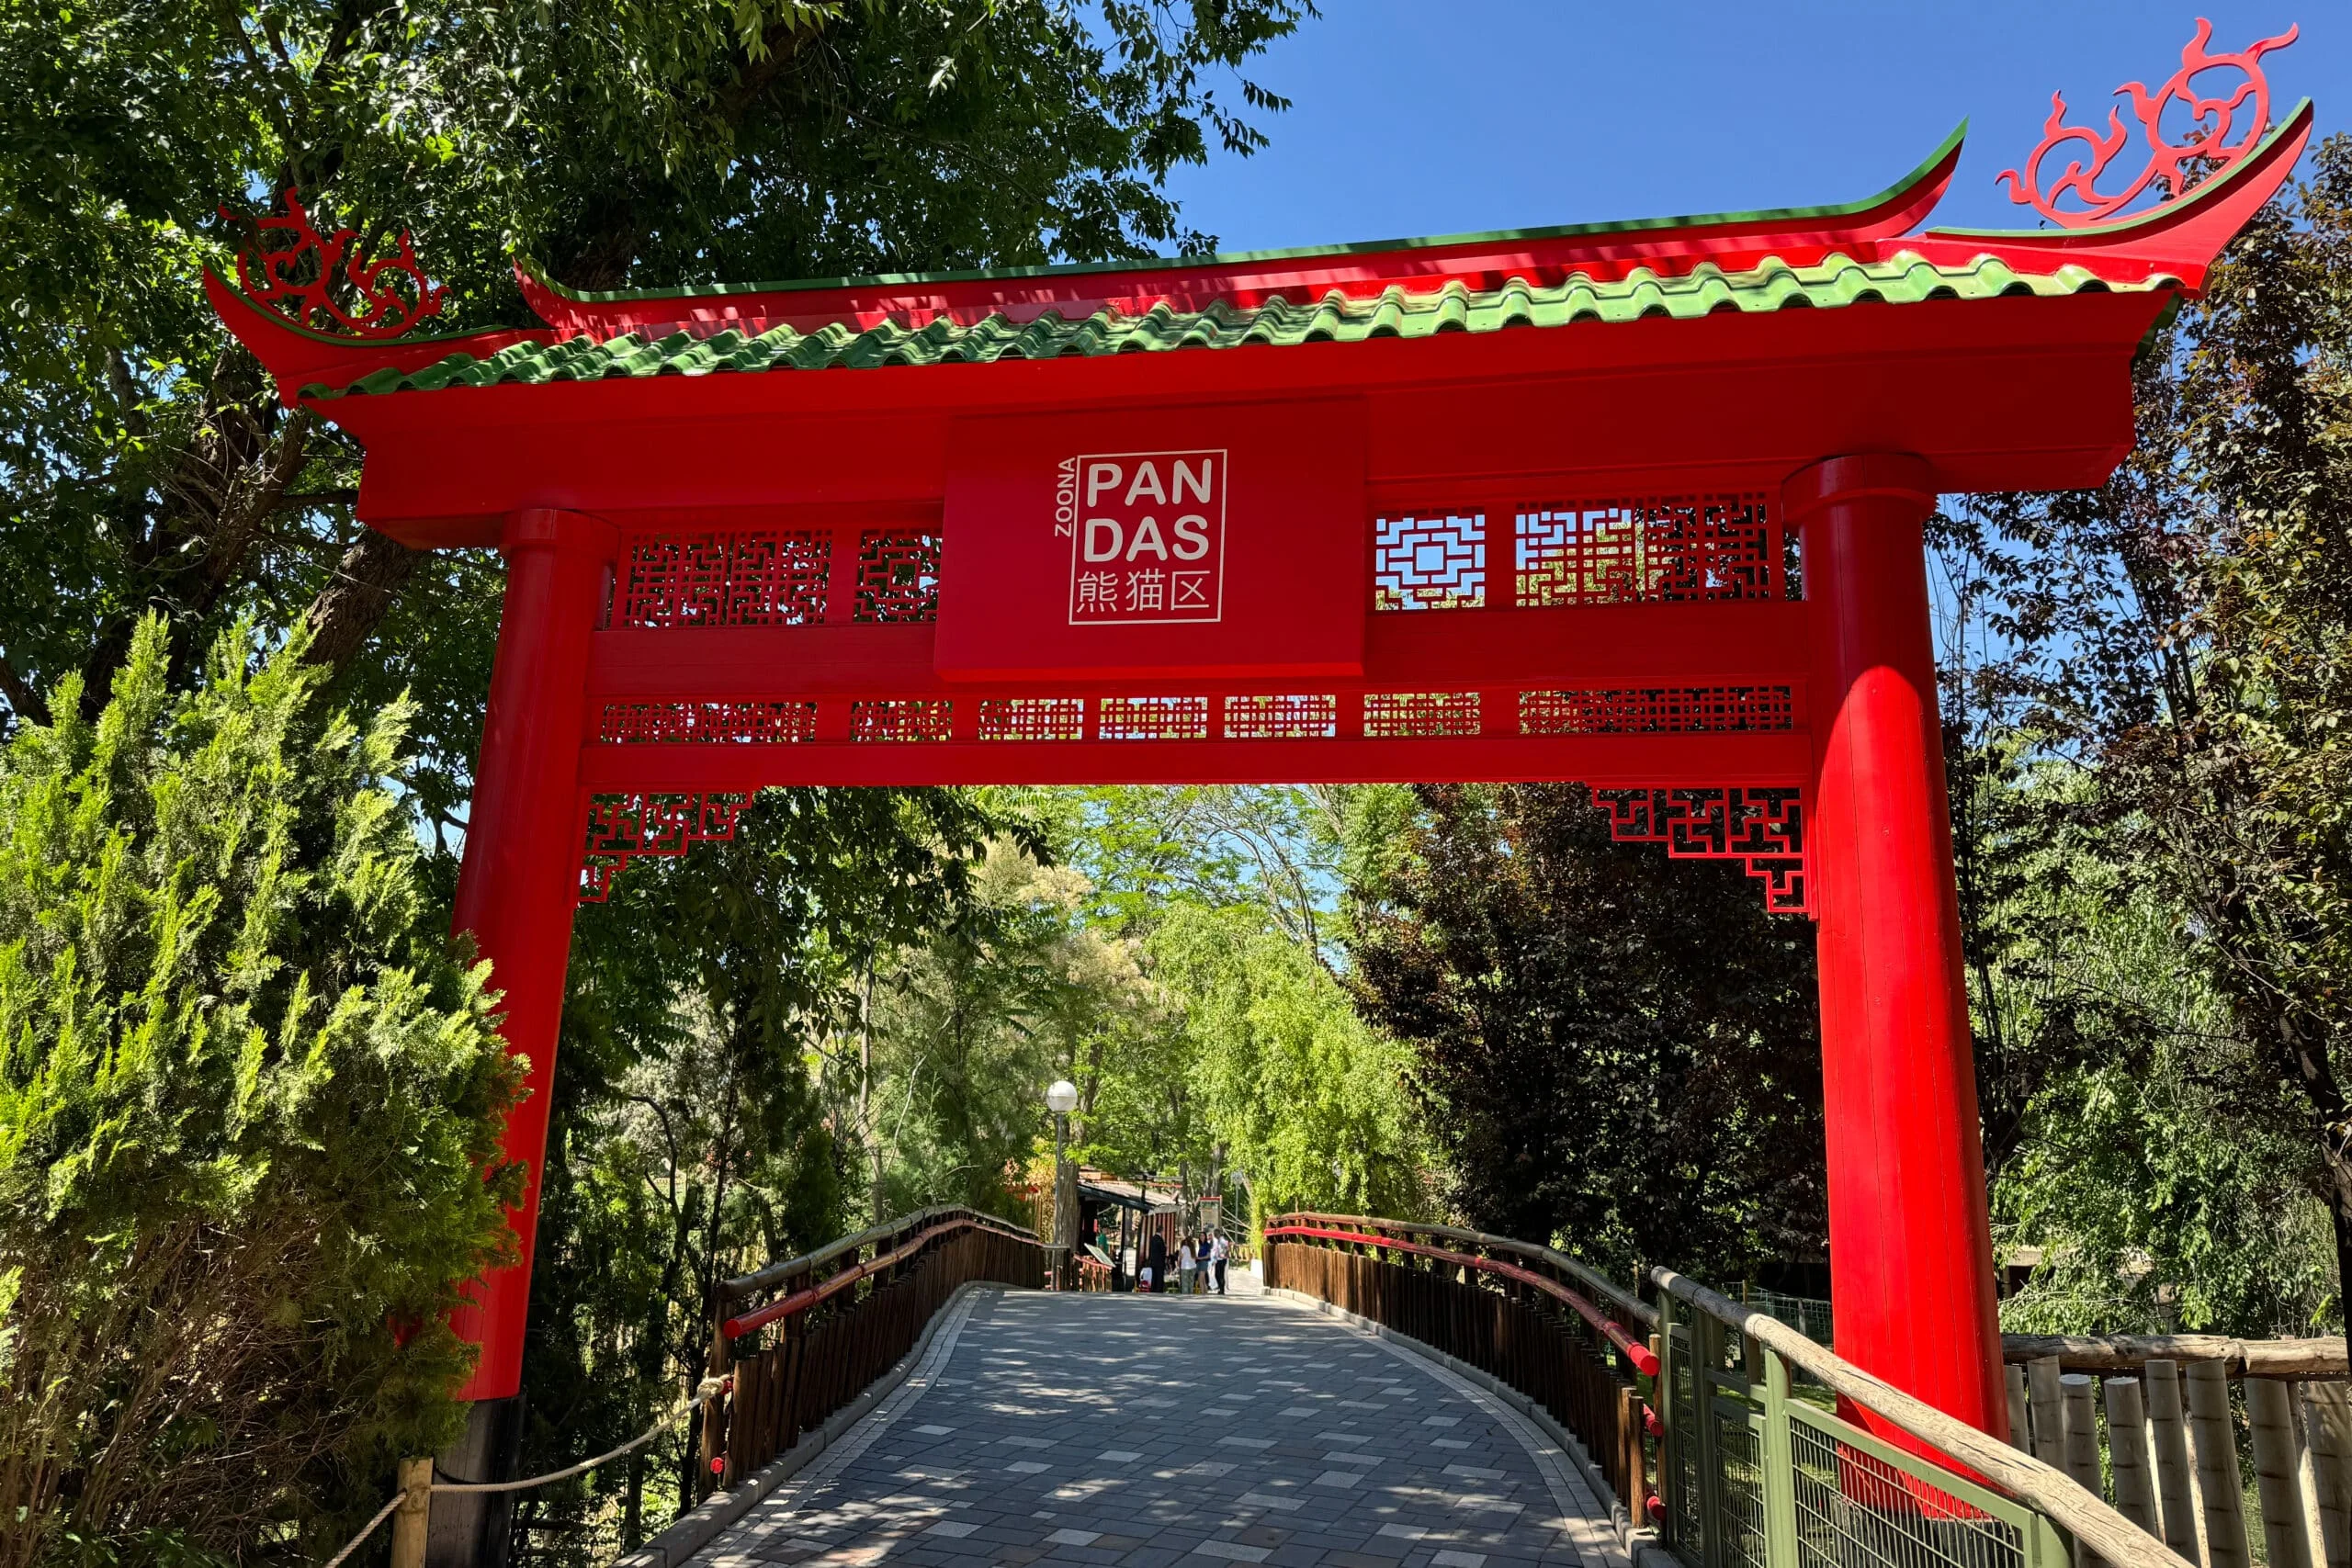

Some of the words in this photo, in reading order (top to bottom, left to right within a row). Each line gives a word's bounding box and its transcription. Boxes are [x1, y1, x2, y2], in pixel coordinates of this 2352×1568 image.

[1055, 457, 1076, 537] ZOONA
[1087, 458, 1212, 507] PAN
[1084, 514, 1209, 562] DAS
[1076, 568, 1211, 613] 熊猫区
